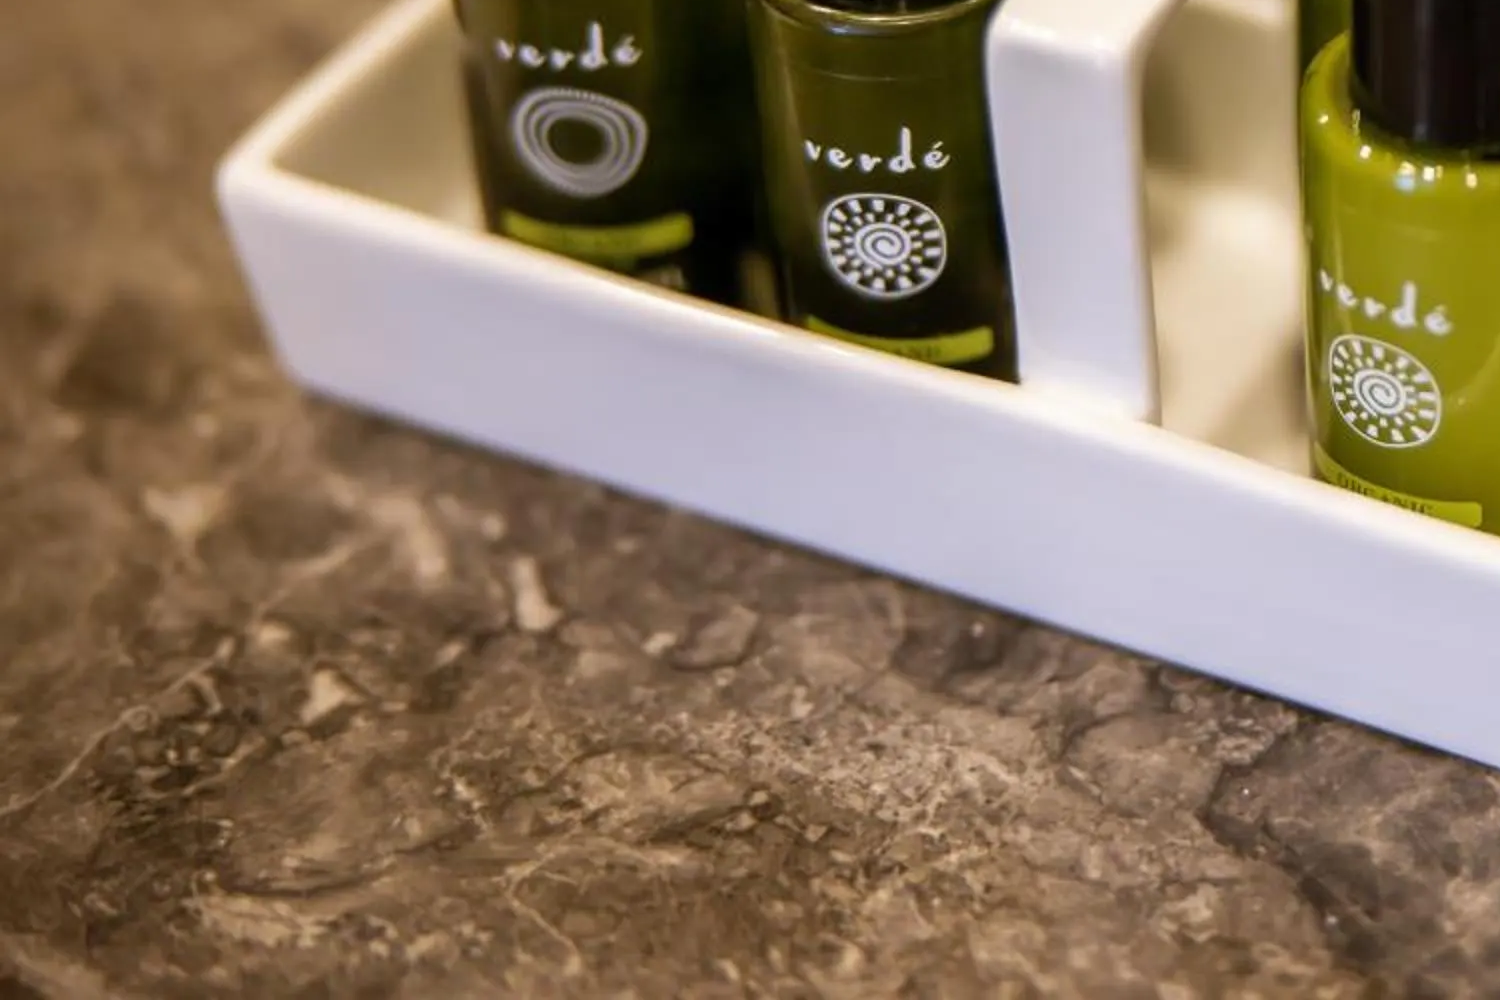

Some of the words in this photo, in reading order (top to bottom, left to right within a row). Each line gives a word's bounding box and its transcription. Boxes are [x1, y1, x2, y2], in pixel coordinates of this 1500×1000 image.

[497, 21, 642, 69] verdé
[804, 126, 951, 173] verdé
[1319, 268, 1453, 336] verdé
